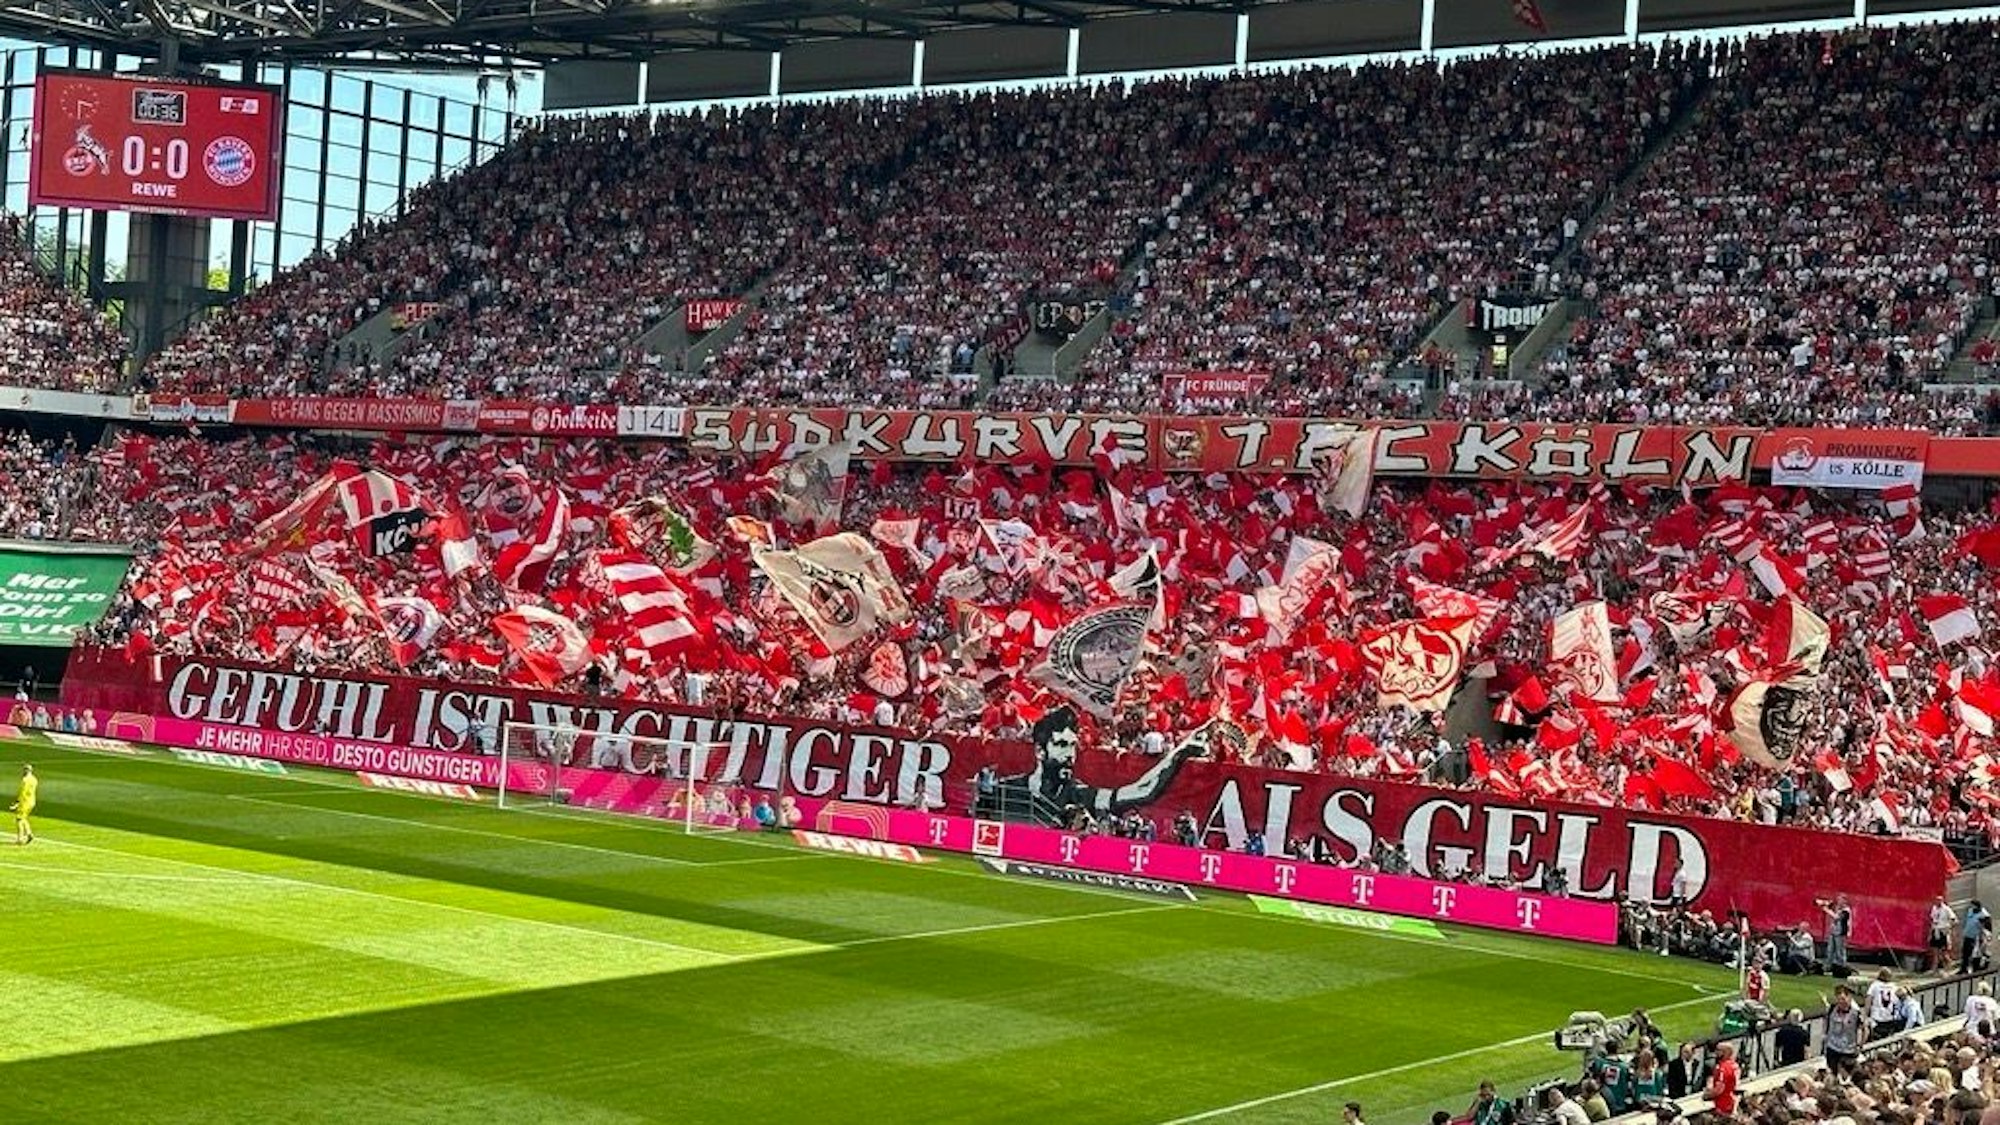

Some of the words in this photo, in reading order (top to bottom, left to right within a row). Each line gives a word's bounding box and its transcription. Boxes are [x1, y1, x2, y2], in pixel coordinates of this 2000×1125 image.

[121, 135, 189, 180] 0:0
[131, 183, 177, 197] REWE
[1202, 377, 1248, 392] FRÜNDE
[323, 402, 367, 422] GEGEN
[367, 402, 441, 424] RASSISMUS
[690, 411, 1148, 464] SÜDKURVE
[1450, 424, 1753, 488] KÖLN
[1826, 443, 1917, 460] PROMINENZ
[1851, 461, 1905, 478] KÖLLE
[7, 573, 88, 589] Mer
[67, 593, 107, 602] zo
[196, 725, 218, 747] JE
[217, 728, 263, 752] MEHR
[264, 731, 292, 757] IHR
[293, 736, 331, 764] SEID,
[332, 742, 385, 771] DESTO
[386, 746, 485, 782] GÜNSTIGER
[410, 688, 516, 756] IST
[530, 700, 953, 810] WICHTIGER
[1198, 779, 1376, 868] ALS
[1403, 798, 1709, 907] GELD
